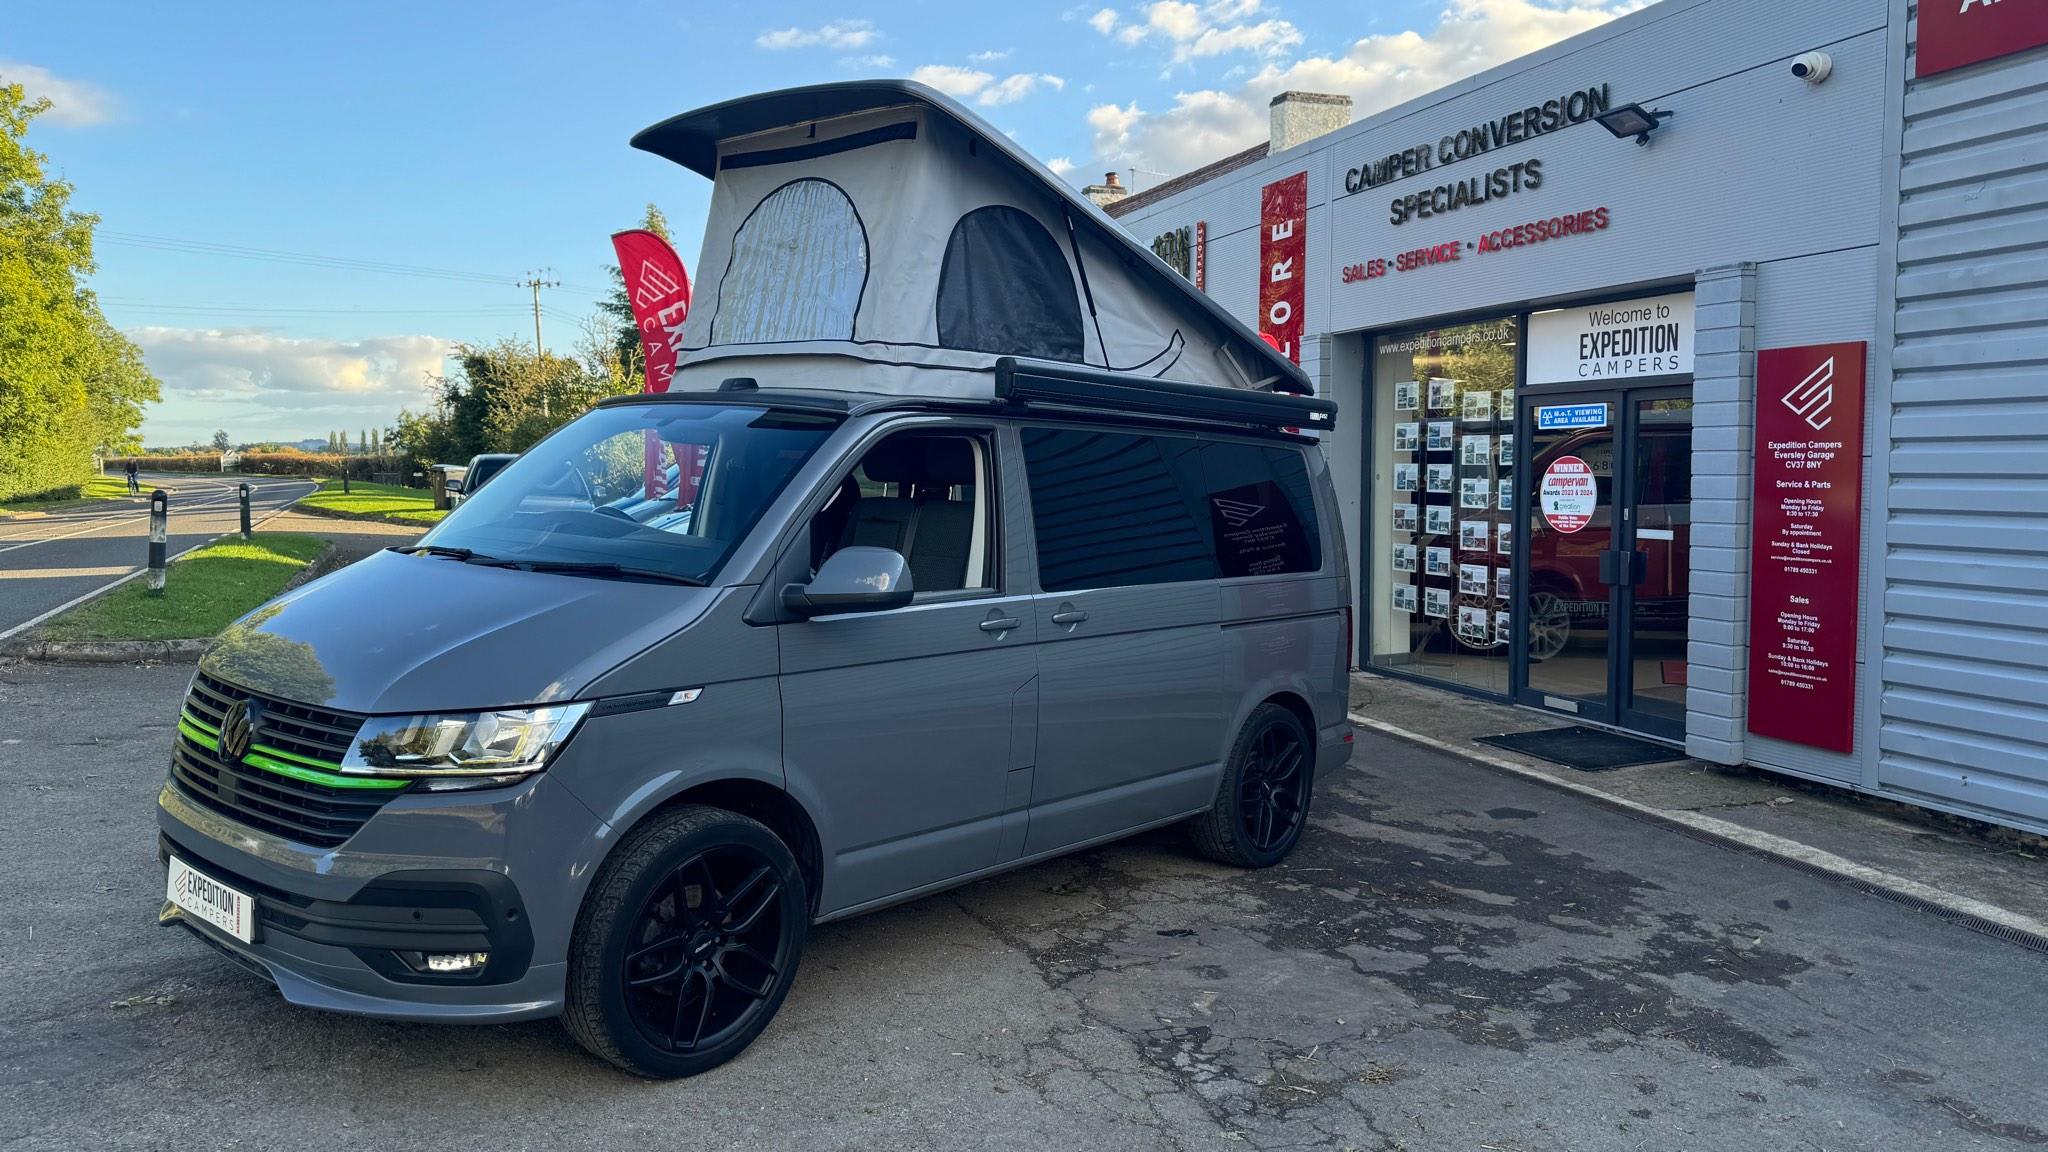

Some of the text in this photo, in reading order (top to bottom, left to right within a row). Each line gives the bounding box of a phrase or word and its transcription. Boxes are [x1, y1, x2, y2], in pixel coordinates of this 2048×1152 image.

[1345, 83, 1611, 194] CAMPER CONVERSION
[1390, 158, 1544, 226] SPECIALISTS
[1342, 206, 1611, 284] SALES SERVICE ACCESSORIES
[1588, 303, 1670, 328] Welcome to
[1379, 327, 1509, 355] www.expeditioncampers.co.uk
[1579, 322, 1679, 361] EXPEDITION
[1578, 354, 1679, 377] CAMPERS
[1574, 408, 1602, 416] VIEWING
[1768, 440, 1842, 450] Expedition Campers
[1774, 451, 1835, 460] Eversley Garage
[1553, 463, 1584, 473] WINNER
[1785, 461, 1822, 469] CV37 8NY
[1548, 477, 1588, 489] campervan
[1776, 480, 1803, 488] Service
[1811, 481, 1831, 489] Parts
[1783, 498, 1805, 506] Opening
[1809, 543, 1832, 551] Holidays
[1789, 594, 1810, 605] Sales
[1553, 601, 1599, 613] EXPEDITION
[1780, 611, 1801, 620] Opening
[1777, 617, 1797, 625] Monday
[1804, 620, 1820, 629] Friday
[1786, 637, 1809, 646] Saturday
[1767, 652, 1787, 661] Sunday
[1805, 658, 1829, 667] Holidays
[187, 870, 234, 916] EXPEDITION
[187, 896, 234, 931] CAMPERS
